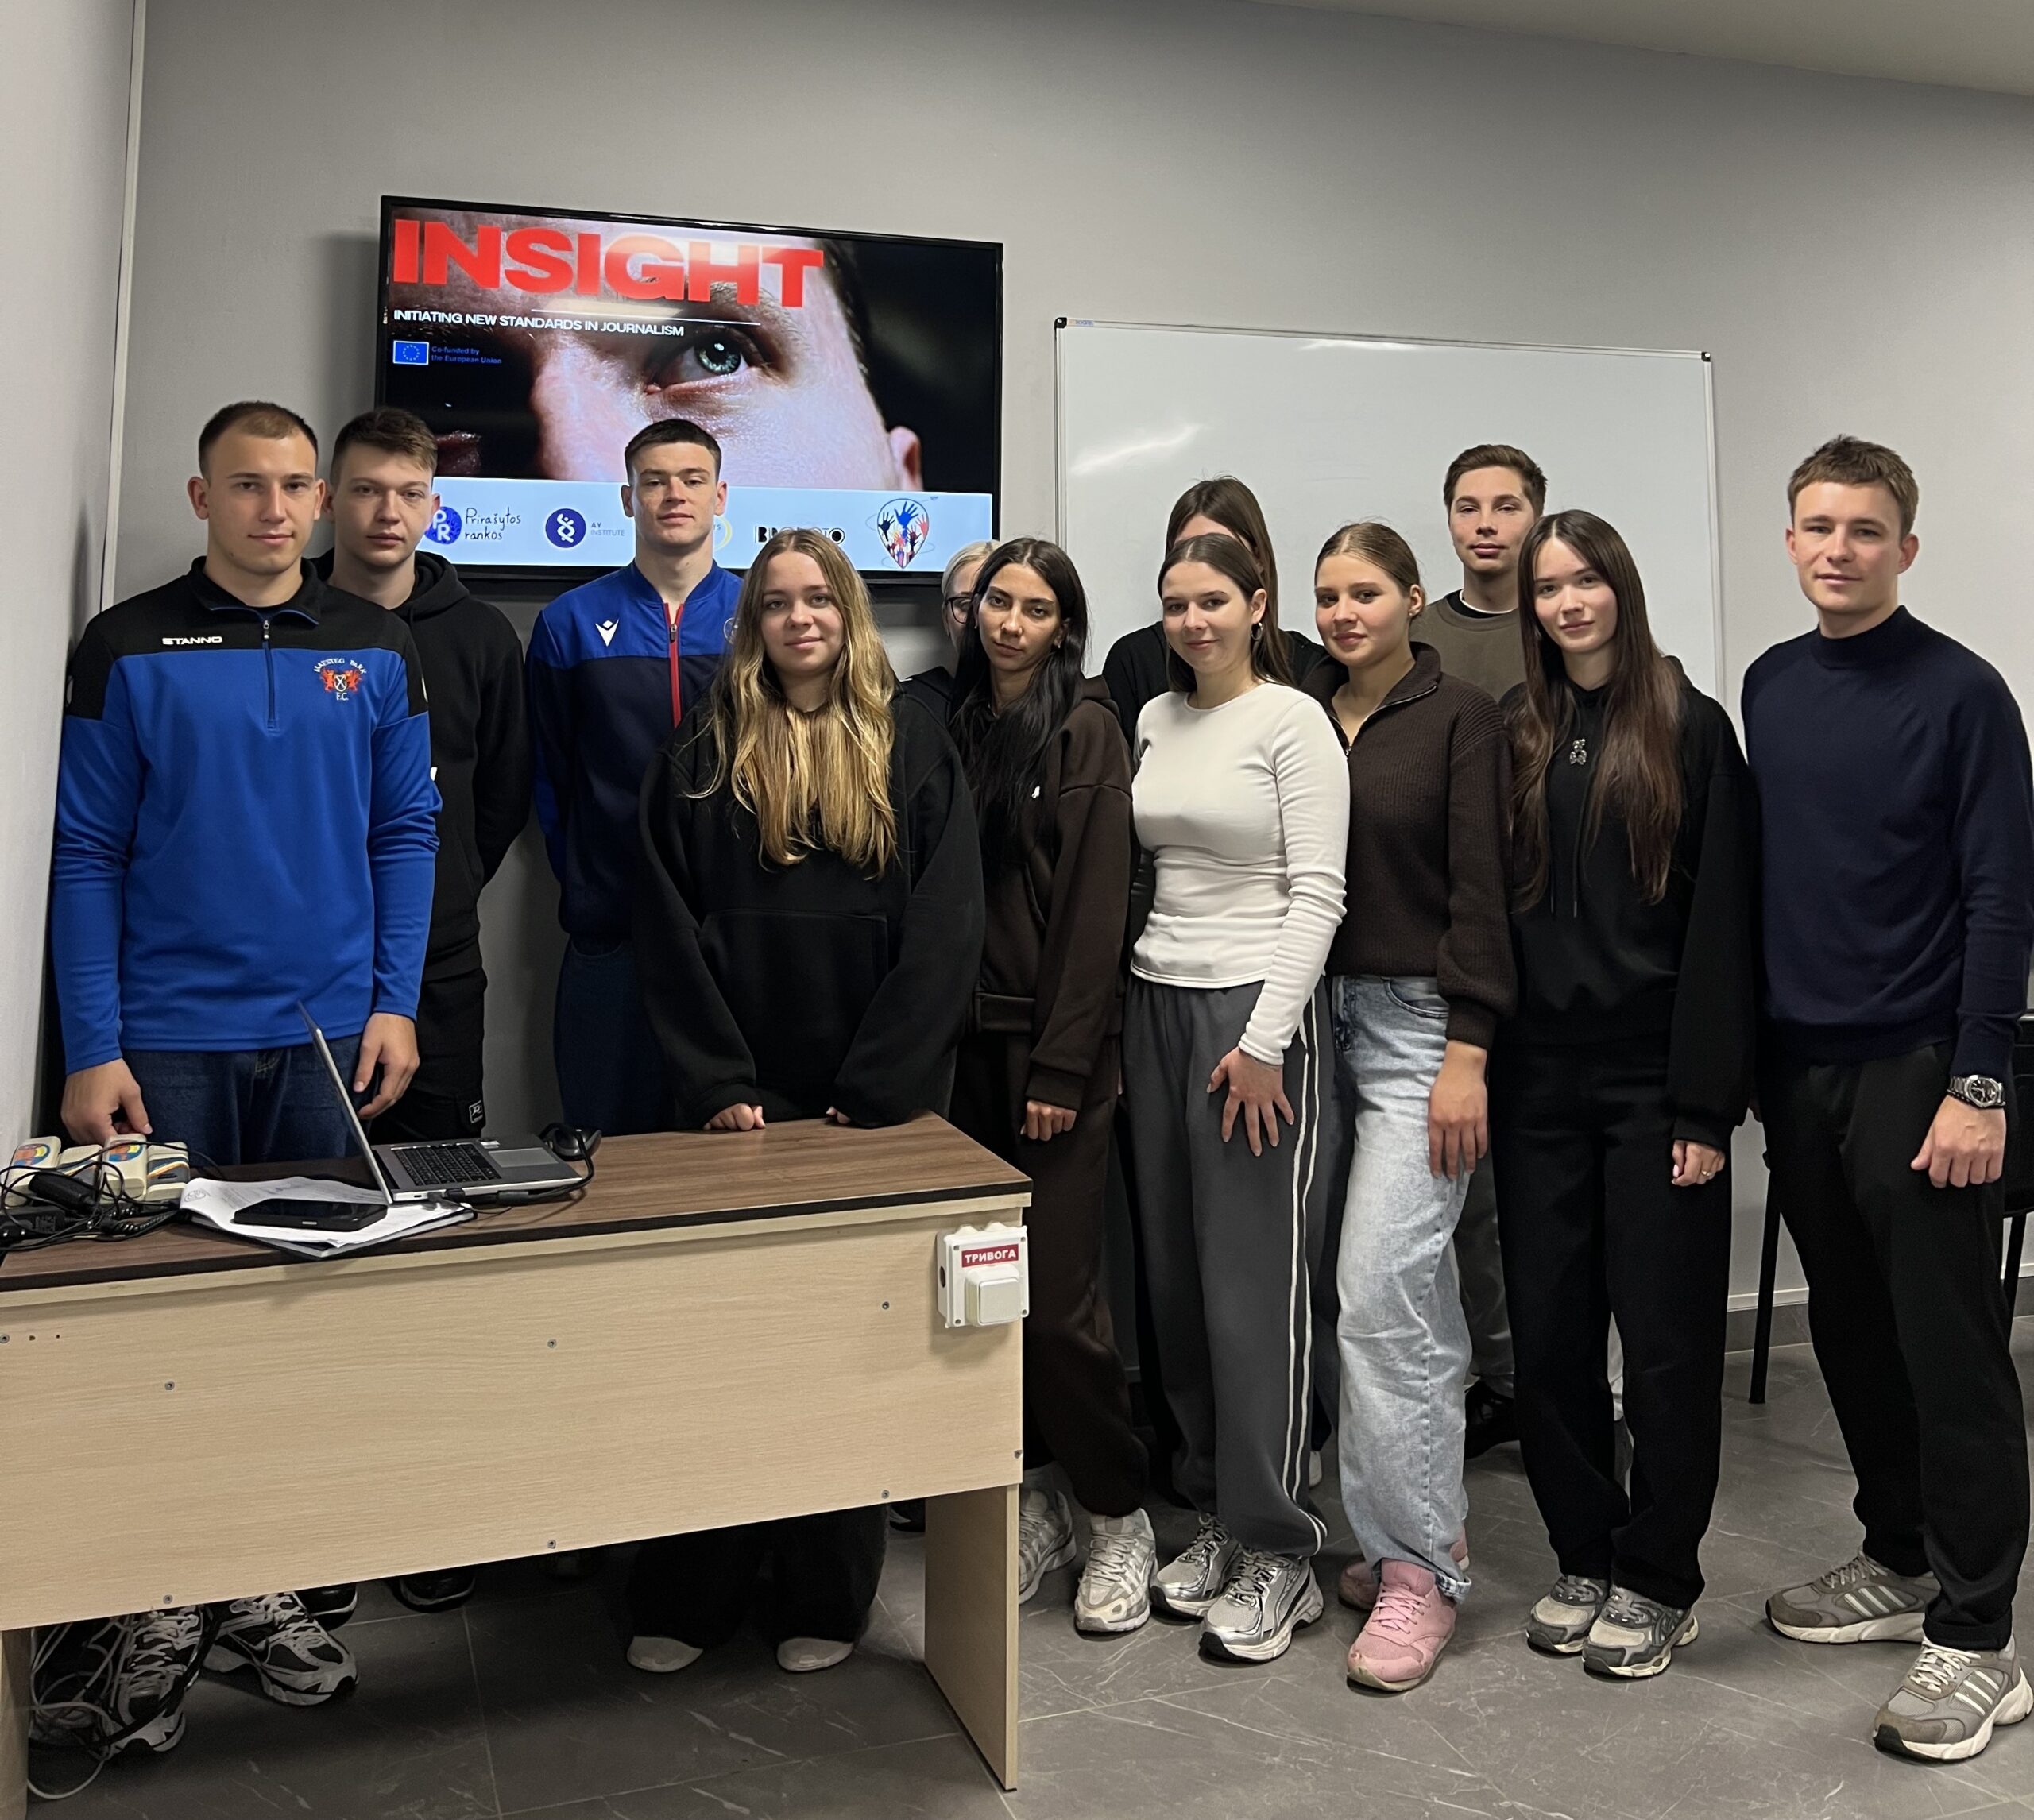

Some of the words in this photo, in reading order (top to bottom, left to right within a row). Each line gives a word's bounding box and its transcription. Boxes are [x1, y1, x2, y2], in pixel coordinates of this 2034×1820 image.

[393, 218, 824, 308] INSIGHT
[393, 309, 463, 325] INITIATING
[465, 315, 497, 327] NEW
[499, 315, 582, 330] STANDARDS
[584, 320, 598, 331] IN
[600, 321, 684, 337] JOURNALISM
[431, 346, 470, 355] Co-funded
[444, 356, 479, 365] European
[465, 507, 522, 531] Prirašytos
[465, 527, 503, 541] rankos
[162, 636, 223, 645] STANNO
[965, 1249, 1016, 1264] ТРИВОГА
